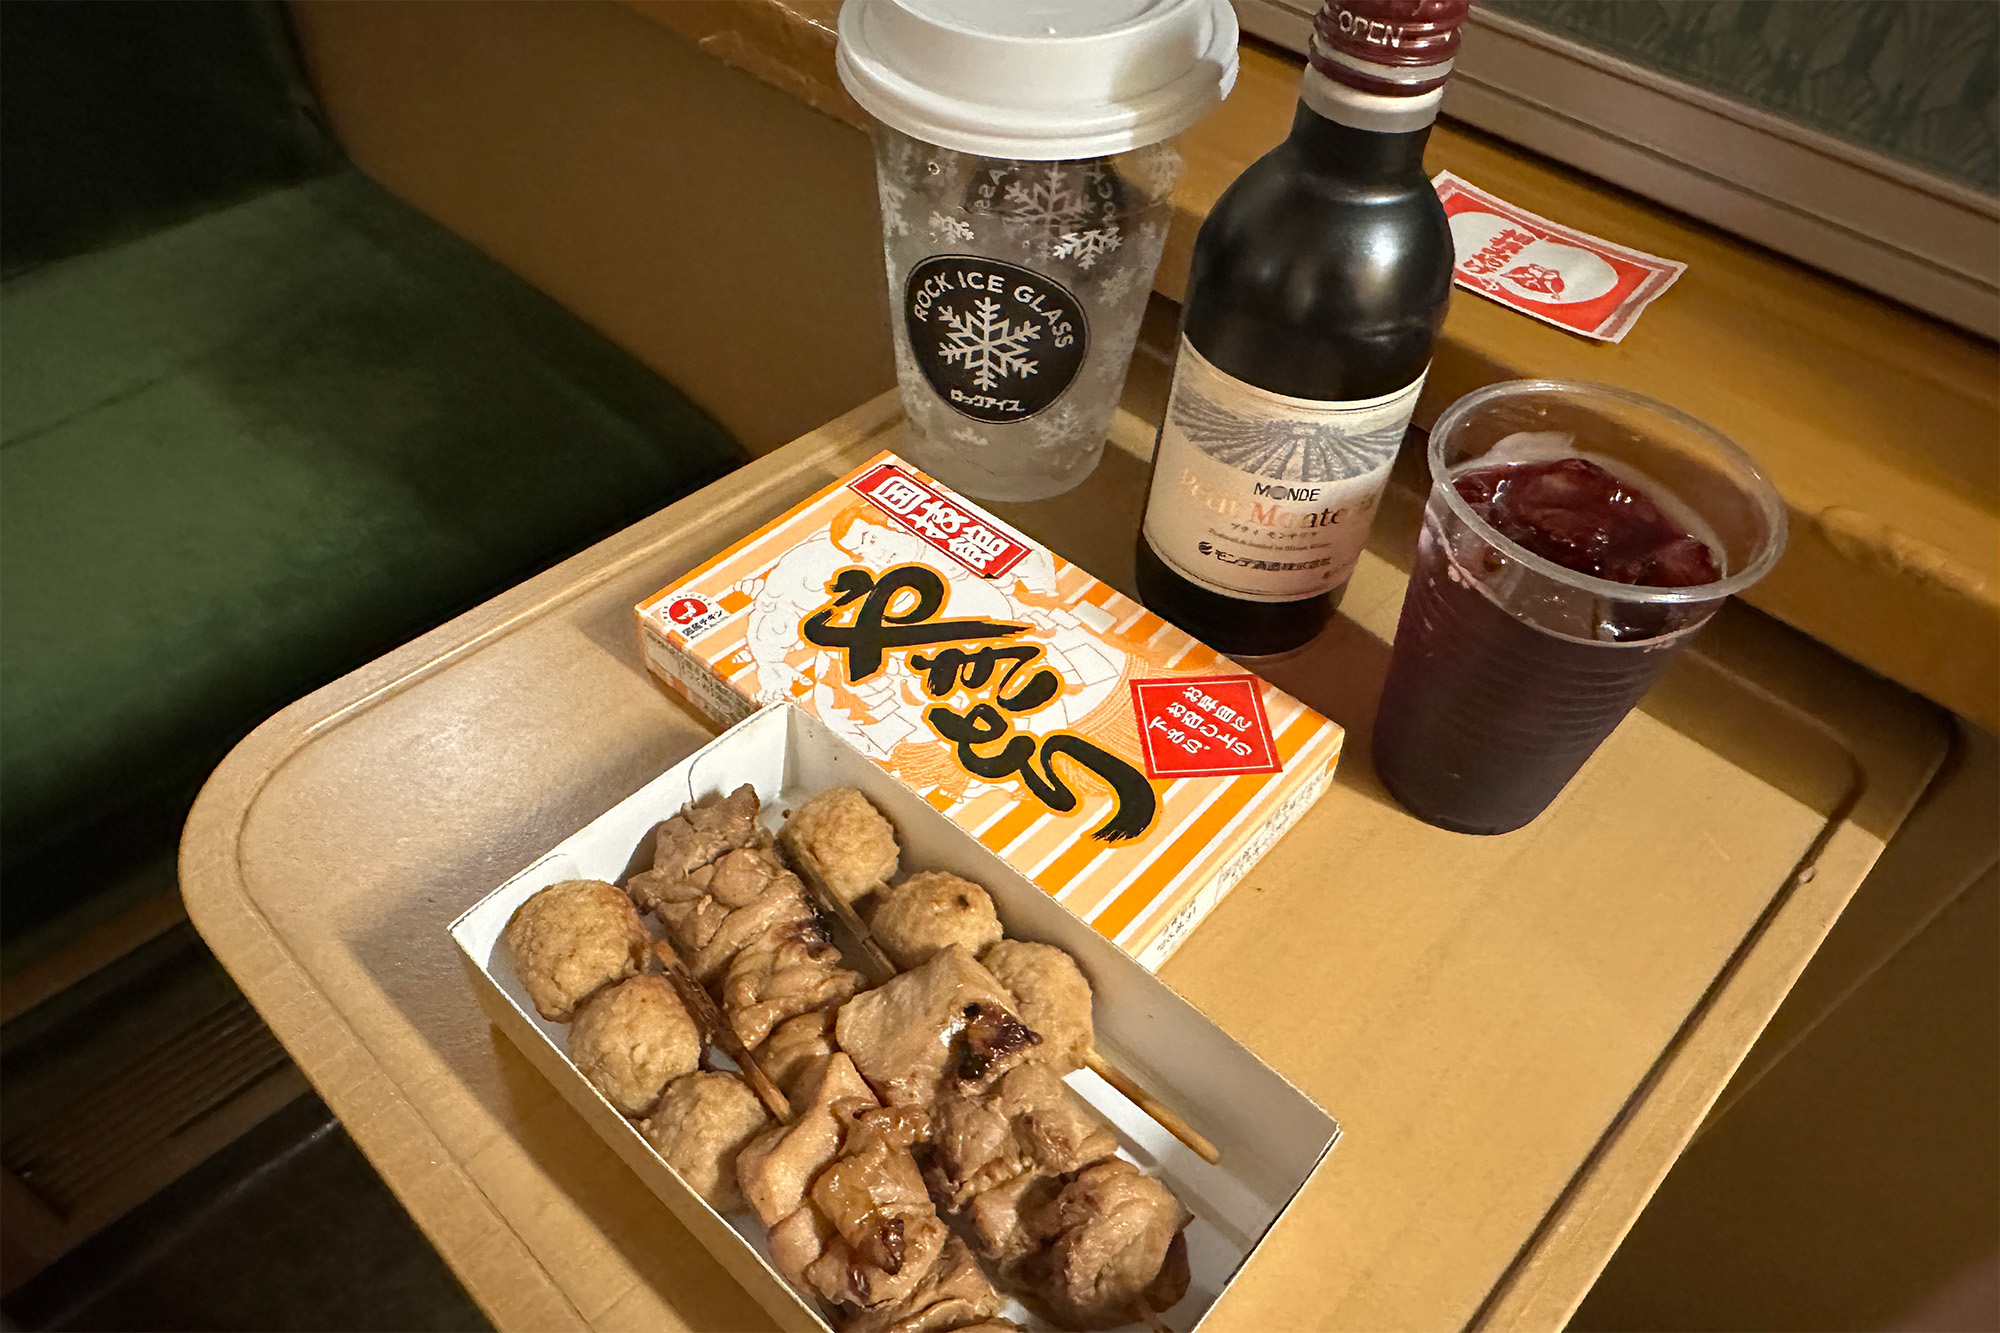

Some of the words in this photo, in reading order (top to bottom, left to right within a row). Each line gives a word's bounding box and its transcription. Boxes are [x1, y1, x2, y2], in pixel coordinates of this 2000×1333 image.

[1338, 9, 1404, 48] OPEN
[914, 271, 955, 322] ROCK
[956, 270, 1005, 294] ICE
[1013, 285, 1074, 349] GLASS
[950, 388, 1026, 412] ロックアイス
[1253, 482, 1321, 502] MONDE
[868, 475, 1011, 570] 国技館
[803, 565, 1157, 844] やきとり
[1165, 701, 1253, 756] お召し上り
[1182, 686, 1252, 732] お早目に
